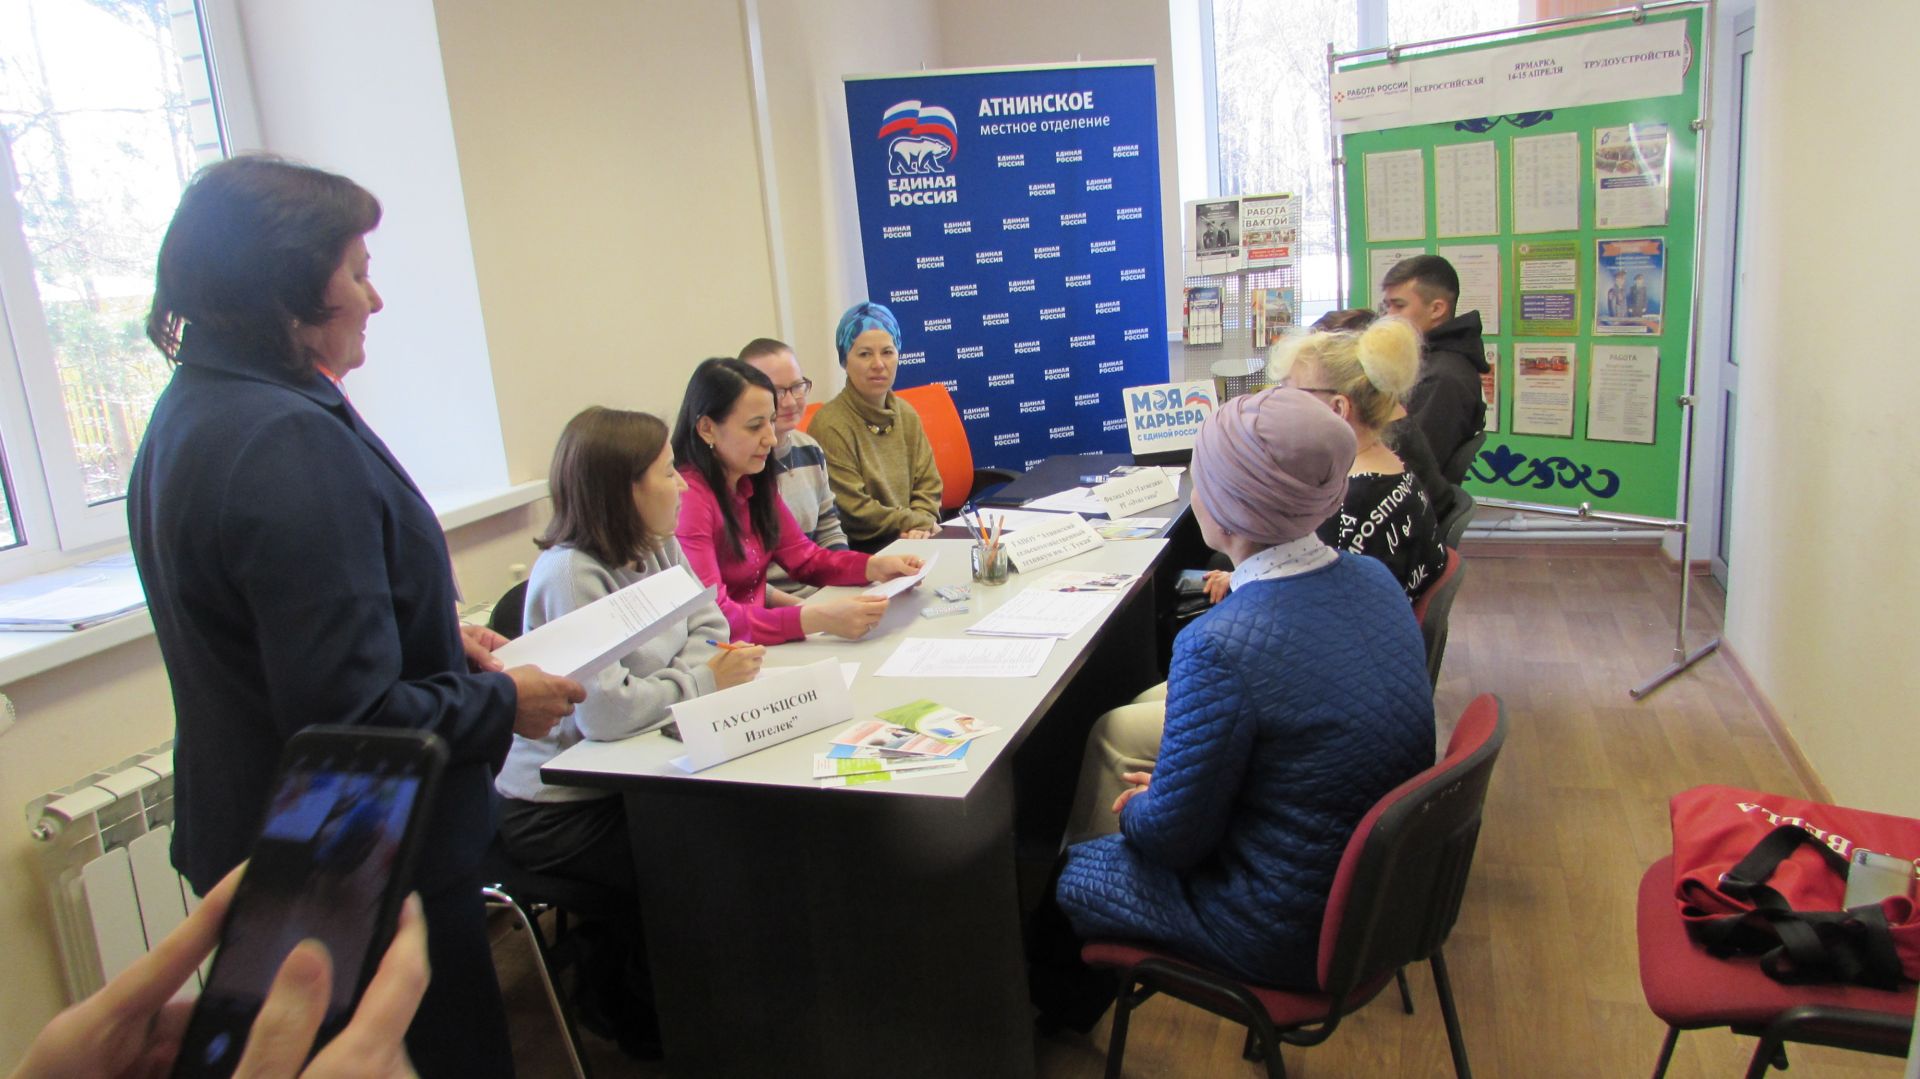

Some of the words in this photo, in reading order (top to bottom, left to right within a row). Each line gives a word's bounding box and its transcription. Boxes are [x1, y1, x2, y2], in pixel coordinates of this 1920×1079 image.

[1514, 58, 1556, 71] ЯРМАРКА
[1584, 50, 1681, 70] ТРУДОУСТРОЙСТВА
[1508, 71, 1527, 81] 14-15
[1528, 66, 1563, 78] АПРЕЛЯ
[1346, 88, 1376, 97] РАБОТА
[1378, 82, 1408, 92] РОССИИ
[1414, 77, 1484, 94] ВСЕРОССИЙСКАЯ
[978, 91, 1094, 118] АТНИНСКОЕ
[980, 120, 1037, 136] местное
[1040, 114, 1110, 133] отделение
[1056, 149, 1082, 157] ЕДИНАЯ
[1056, 155, 1082, 163] РОССИЯ
[888, 176, 956, 192] ЕДИНАЯ
[890, 190, 958, 206] РОССИЯ
[1247, 206, 1286, 216] РАБОТА
[1246, 218, 1288, 228] ВАХТОЙ
[1134, 409, 1204, 430] КАРЬЕРА
[1144, 429, 1174, 440] ЕДИНОЙ
[1174, 428, 1198, 437] РОССИ
[712, 708, 760, 732] ГАУСО
